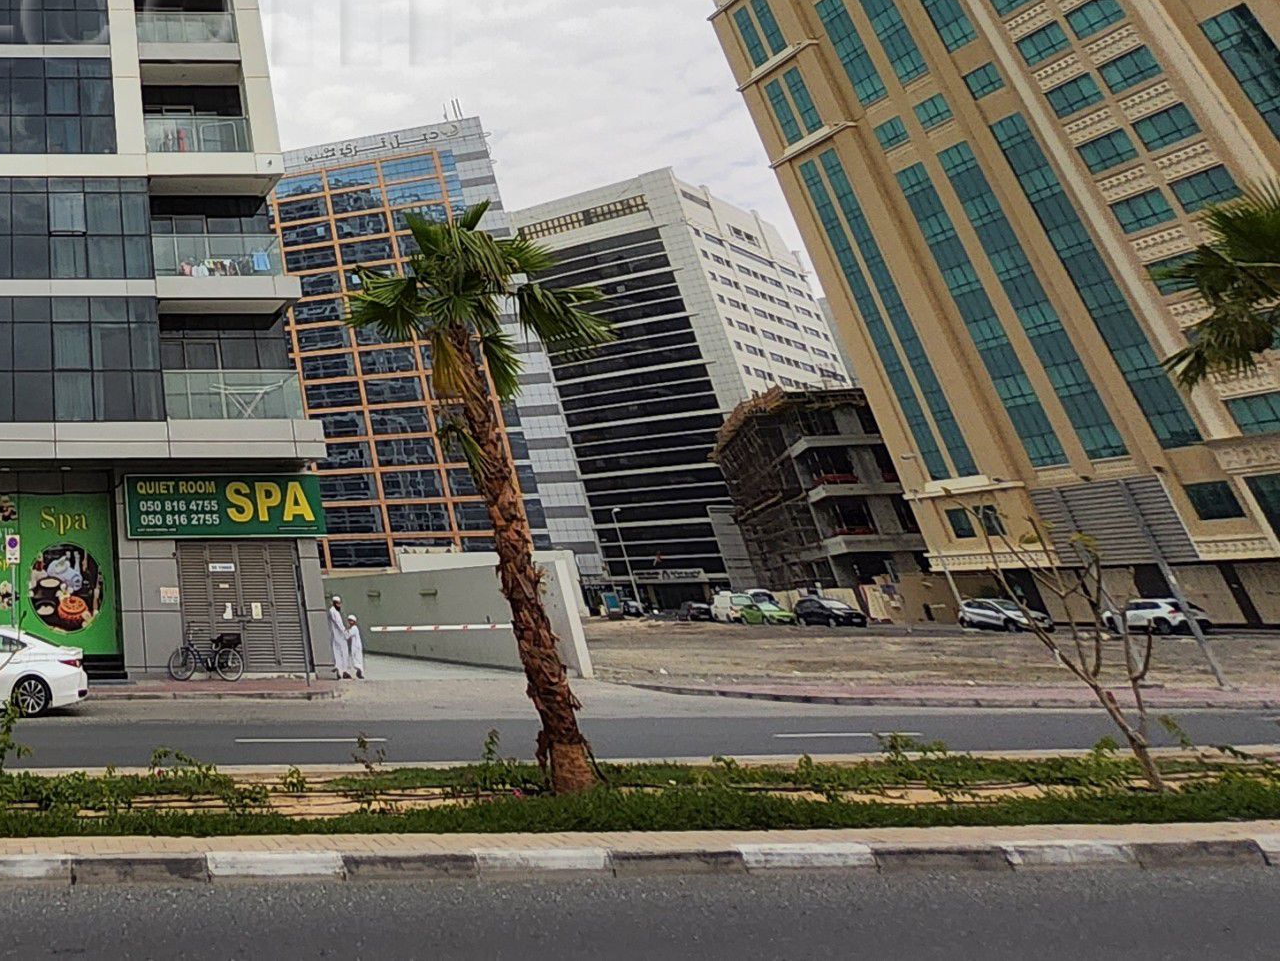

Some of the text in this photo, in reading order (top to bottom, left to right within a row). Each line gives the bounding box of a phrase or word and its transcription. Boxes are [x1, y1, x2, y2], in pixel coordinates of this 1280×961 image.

[136, 480, 216, 495] QUIET ROOM
[139, 500, 219, 512] 050 816 4755
[225, 480, 316, 523] SPA
[40, 505, 89, 536] Spa
[140, 513, 220, 526] 050 816 2755
